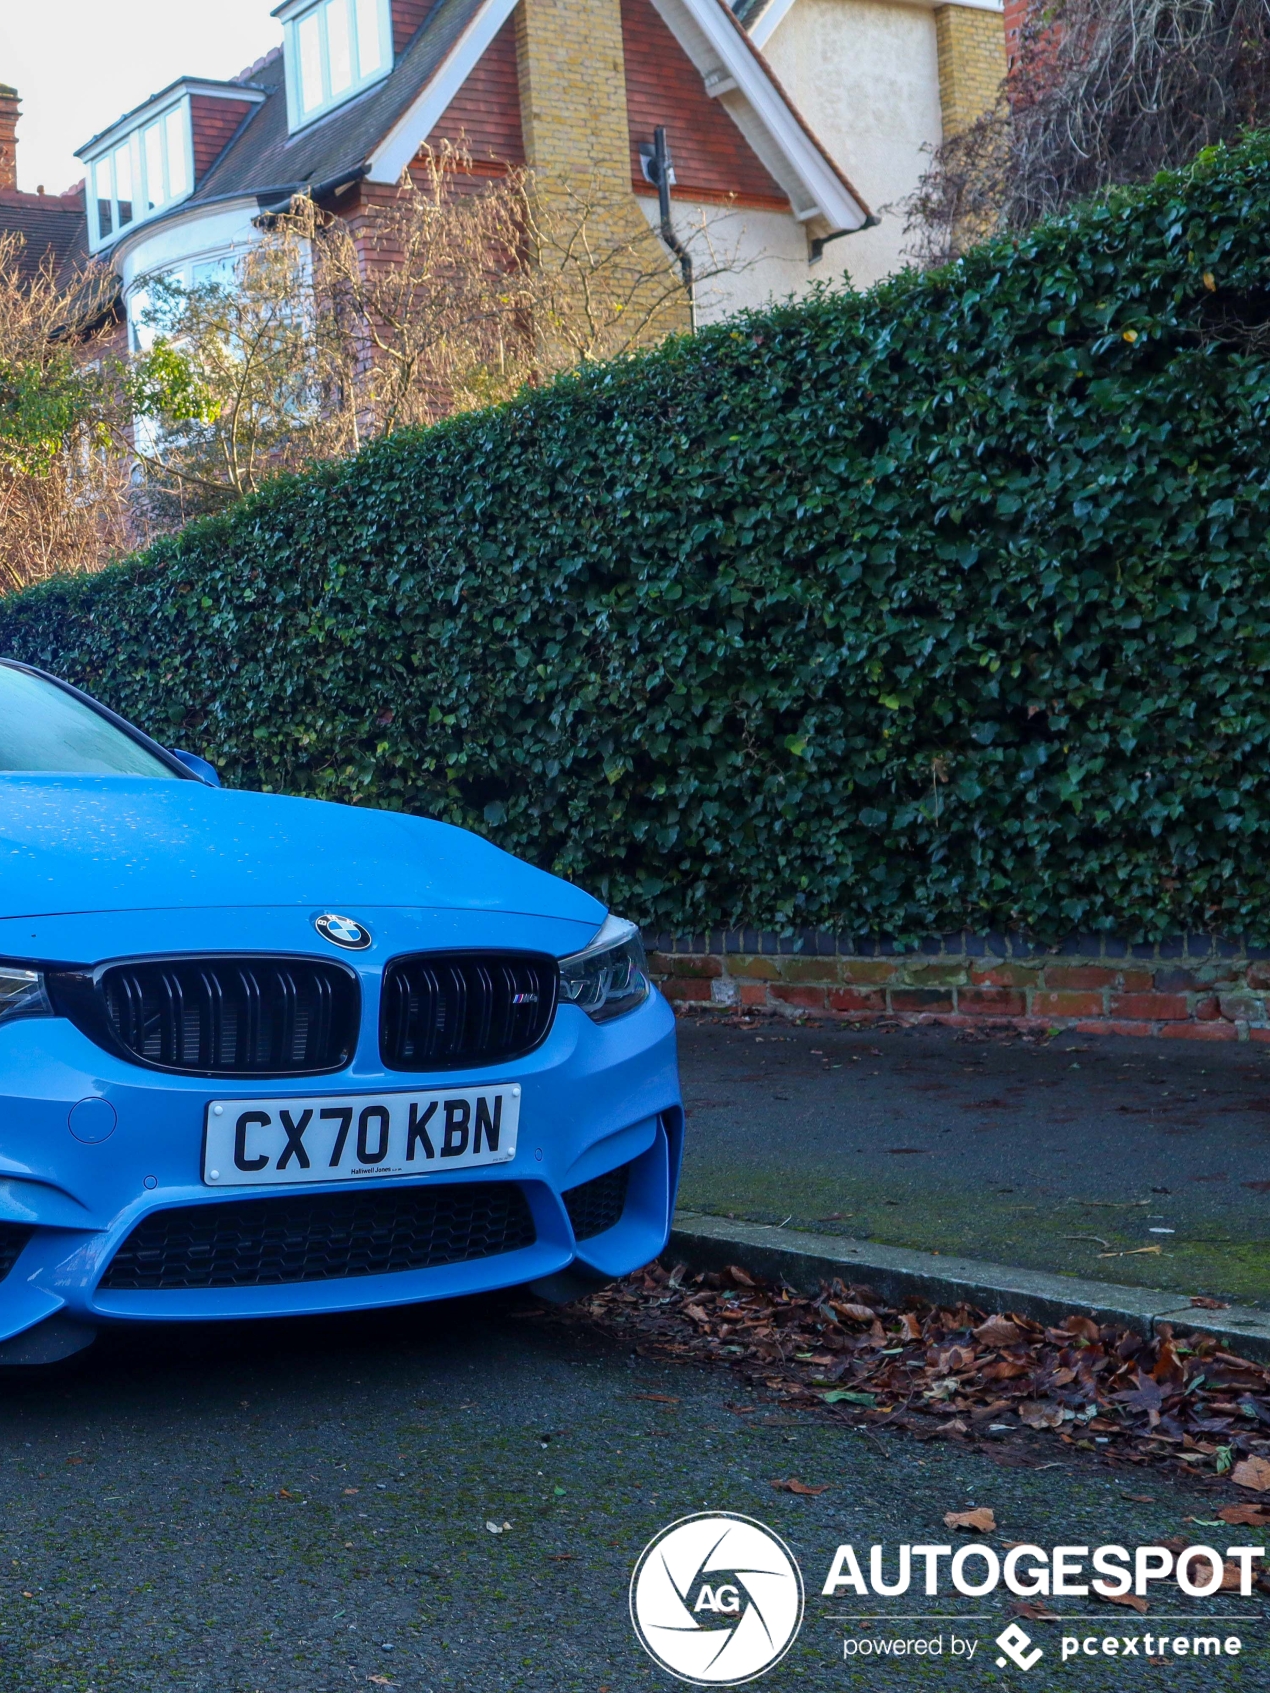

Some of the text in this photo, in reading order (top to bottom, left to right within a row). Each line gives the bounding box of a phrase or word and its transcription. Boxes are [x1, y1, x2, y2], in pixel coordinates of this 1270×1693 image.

[234, 1095, 503, 1172] CX70 KBN
[351, 1167, 374, 1175] Halliwell
